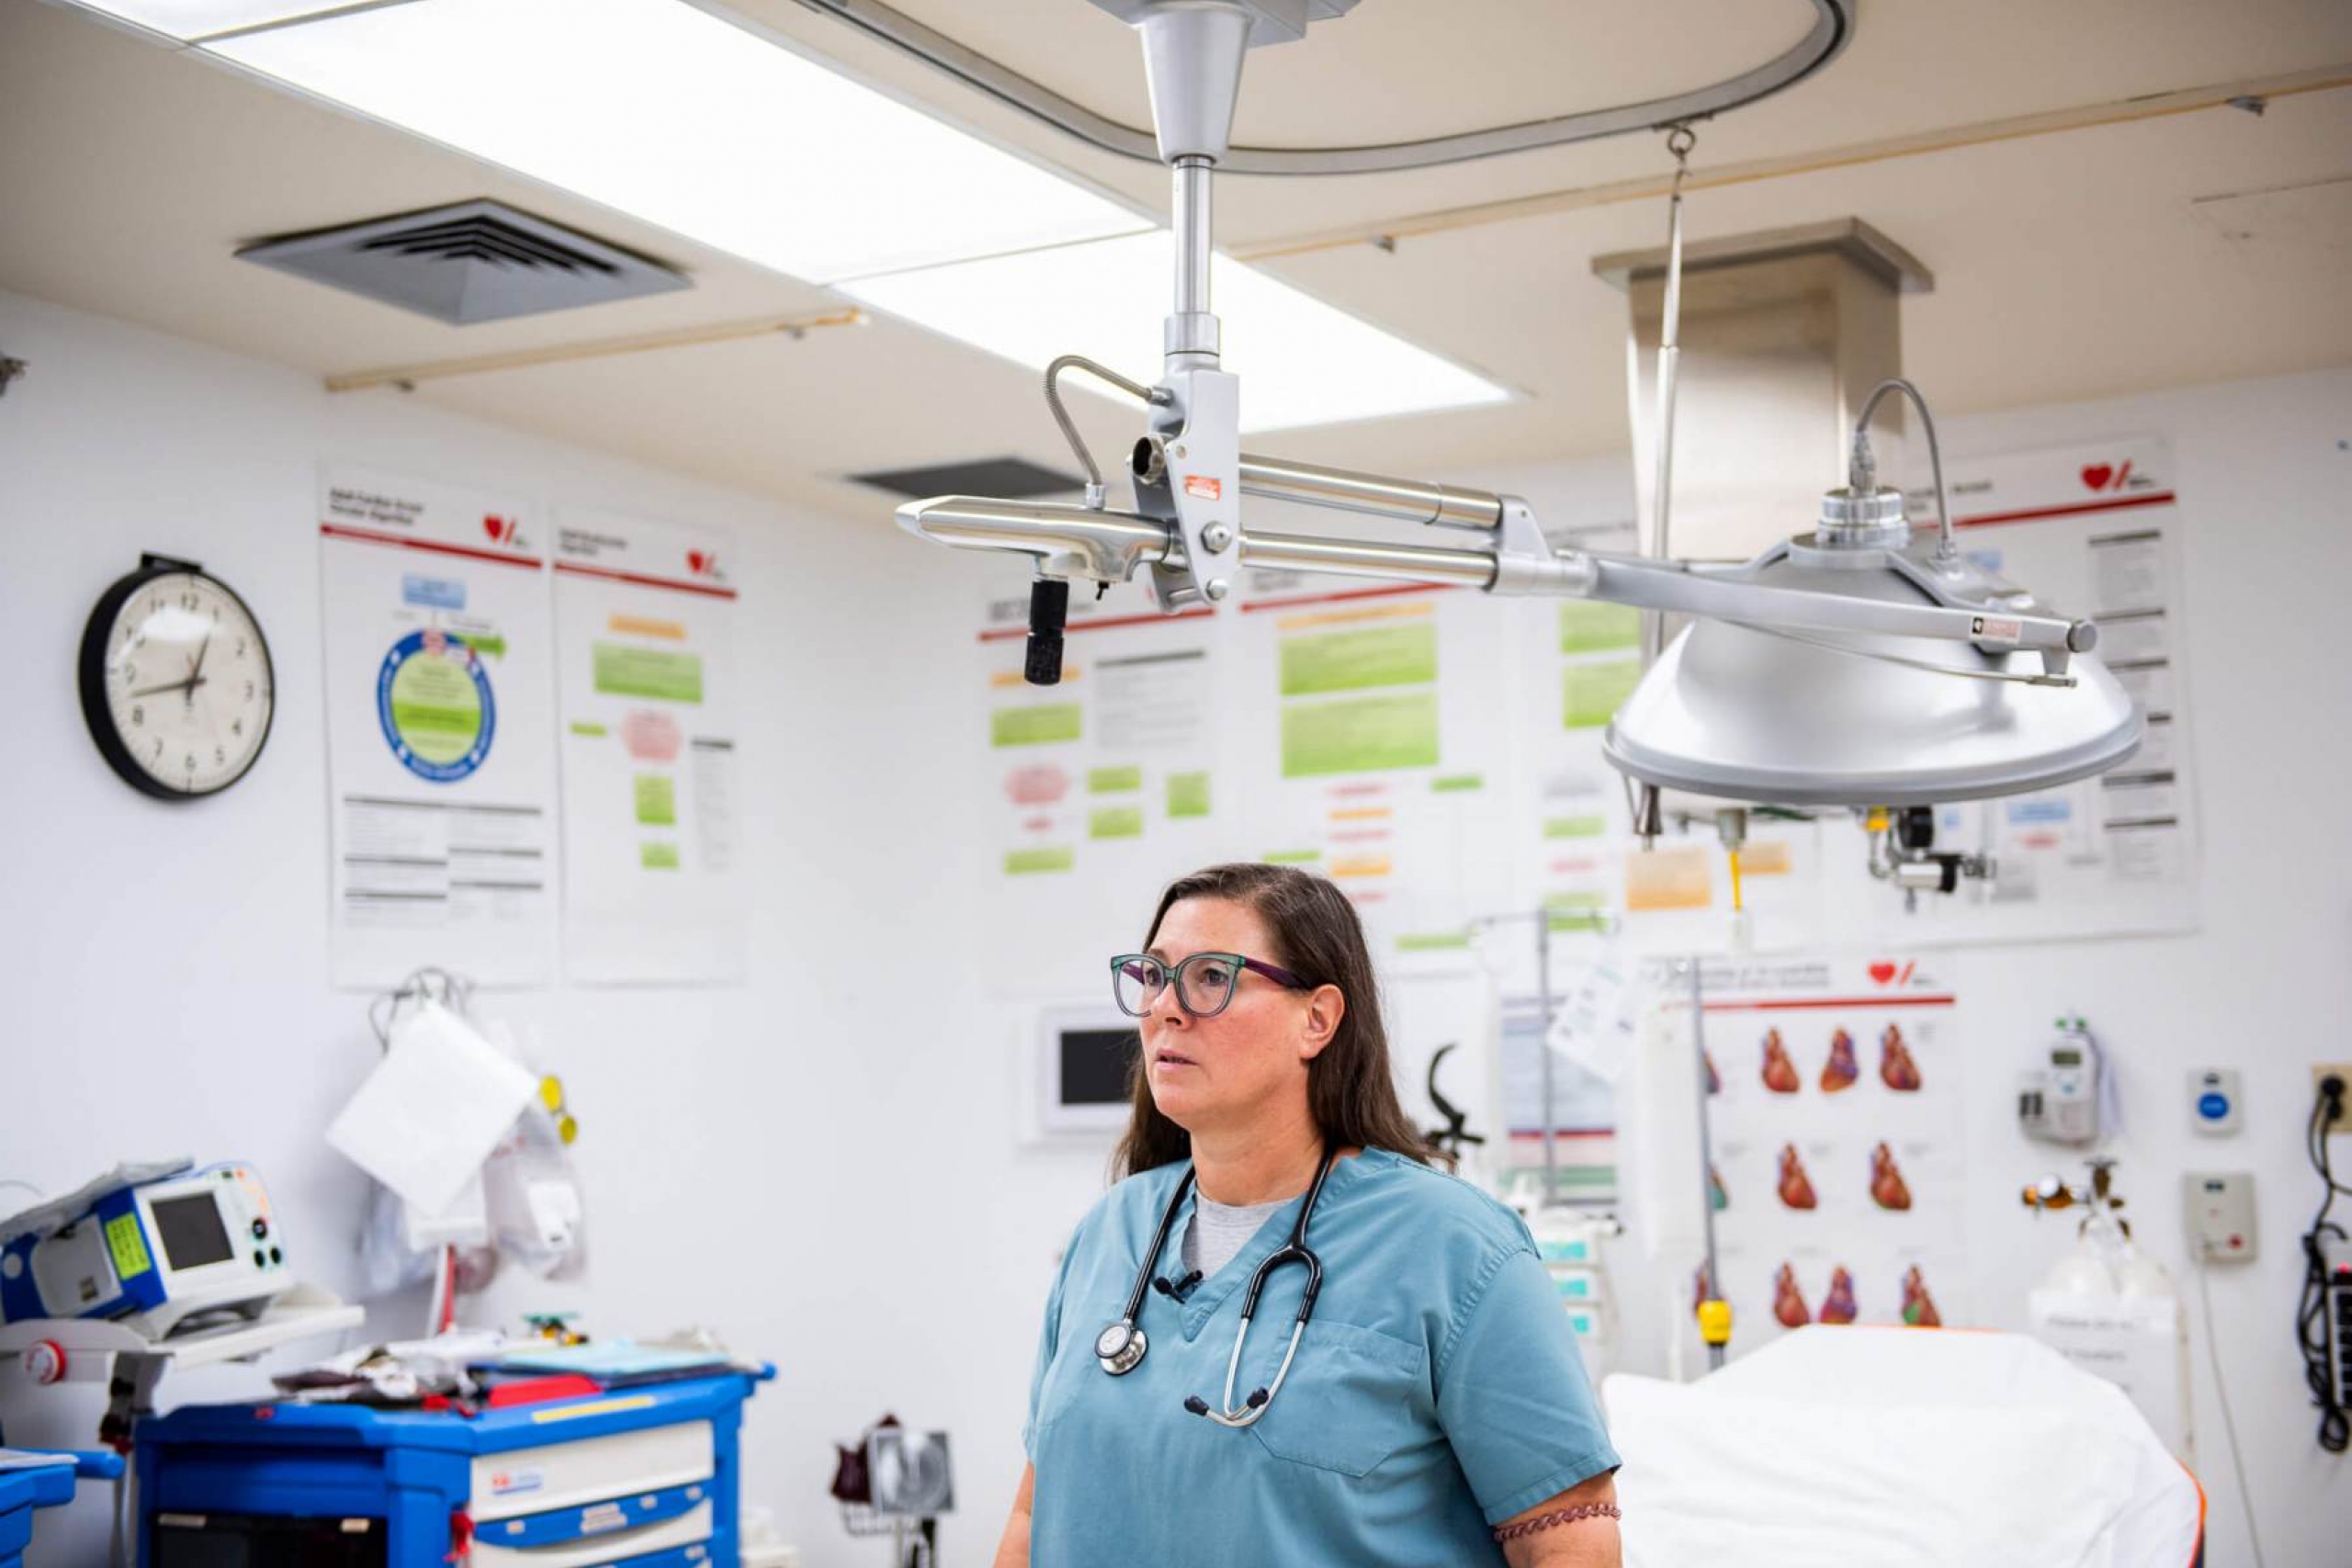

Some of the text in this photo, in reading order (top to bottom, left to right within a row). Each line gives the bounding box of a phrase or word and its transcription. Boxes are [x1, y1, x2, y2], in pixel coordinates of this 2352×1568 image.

[182, 593, 198, 612] 12
[244, 682, 254, 701] 3
[133, 705, 144, 725] 8
[232, 721, 242, 737] 4
[186, 753, 196, 770] 6
